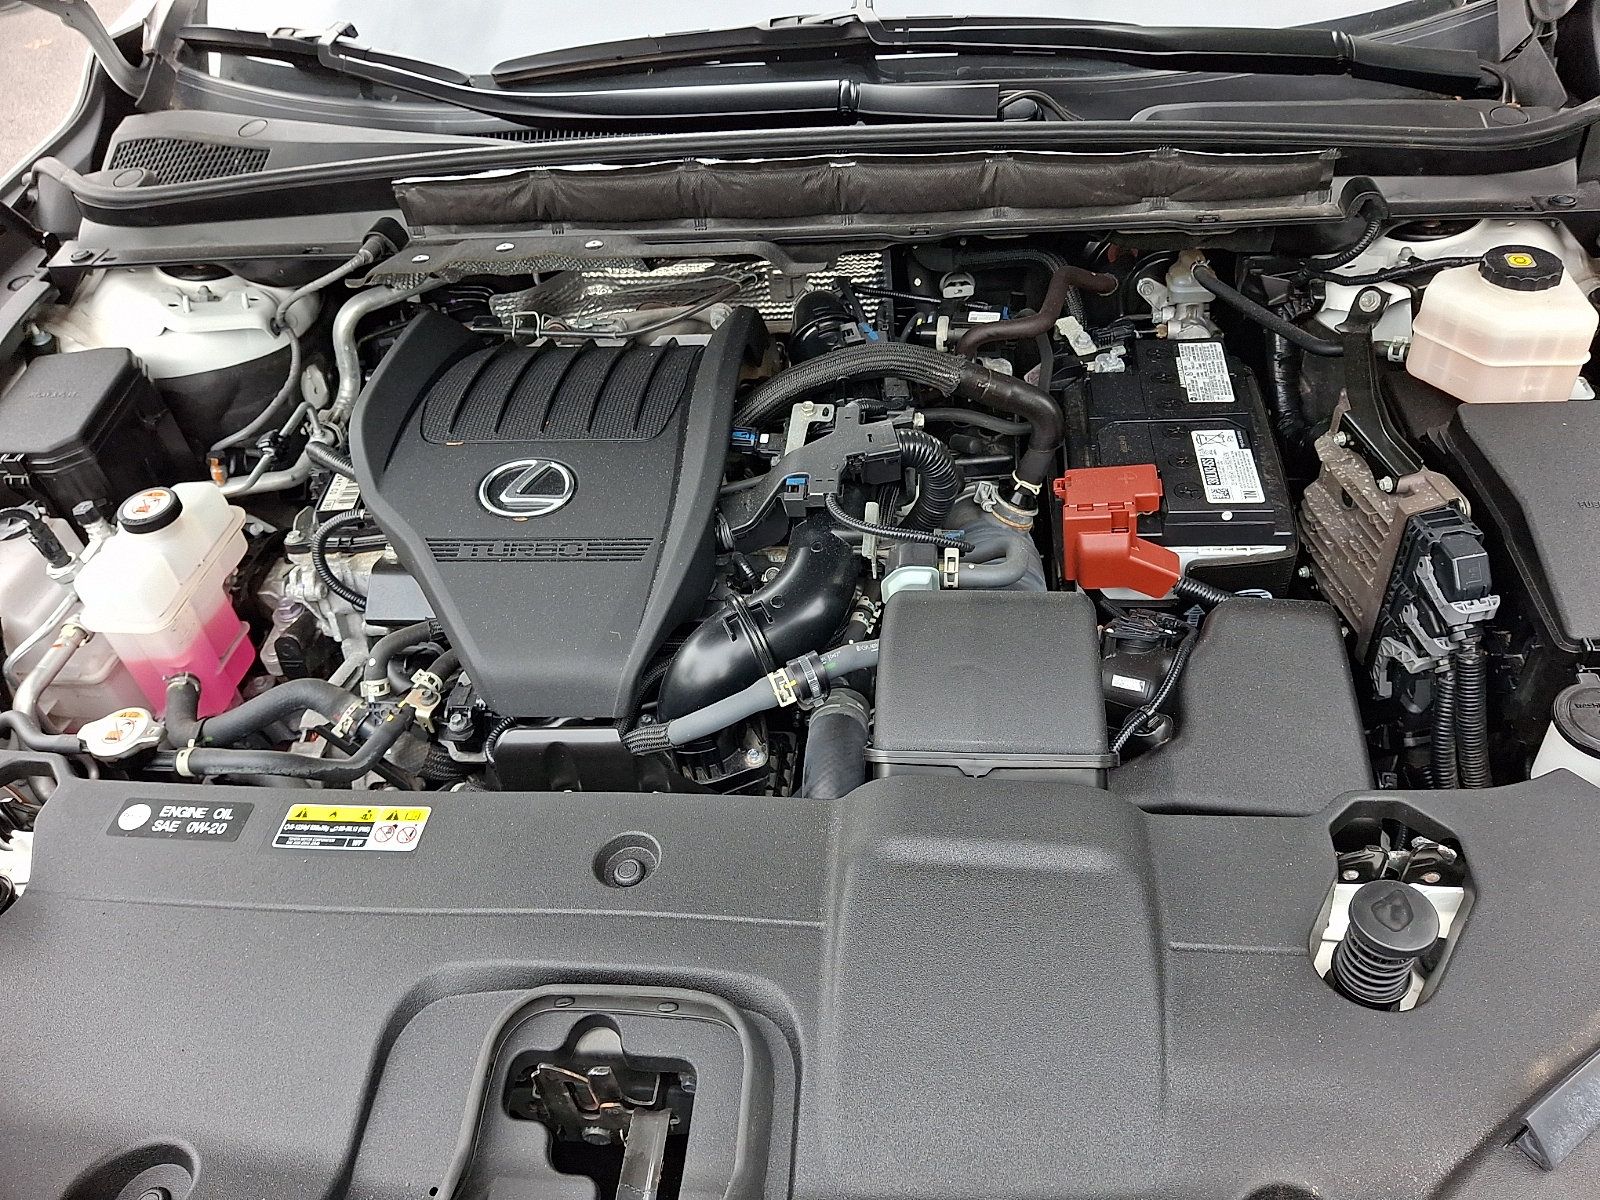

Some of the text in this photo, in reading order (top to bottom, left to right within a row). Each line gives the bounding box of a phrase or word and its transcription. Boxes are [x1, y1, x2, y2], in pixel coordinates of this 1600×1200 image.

[462, 542, 584, 557] TURBO
[159, 806, 234, 820] ENGINE OIL
[152, 820, 181, 832] SAE
